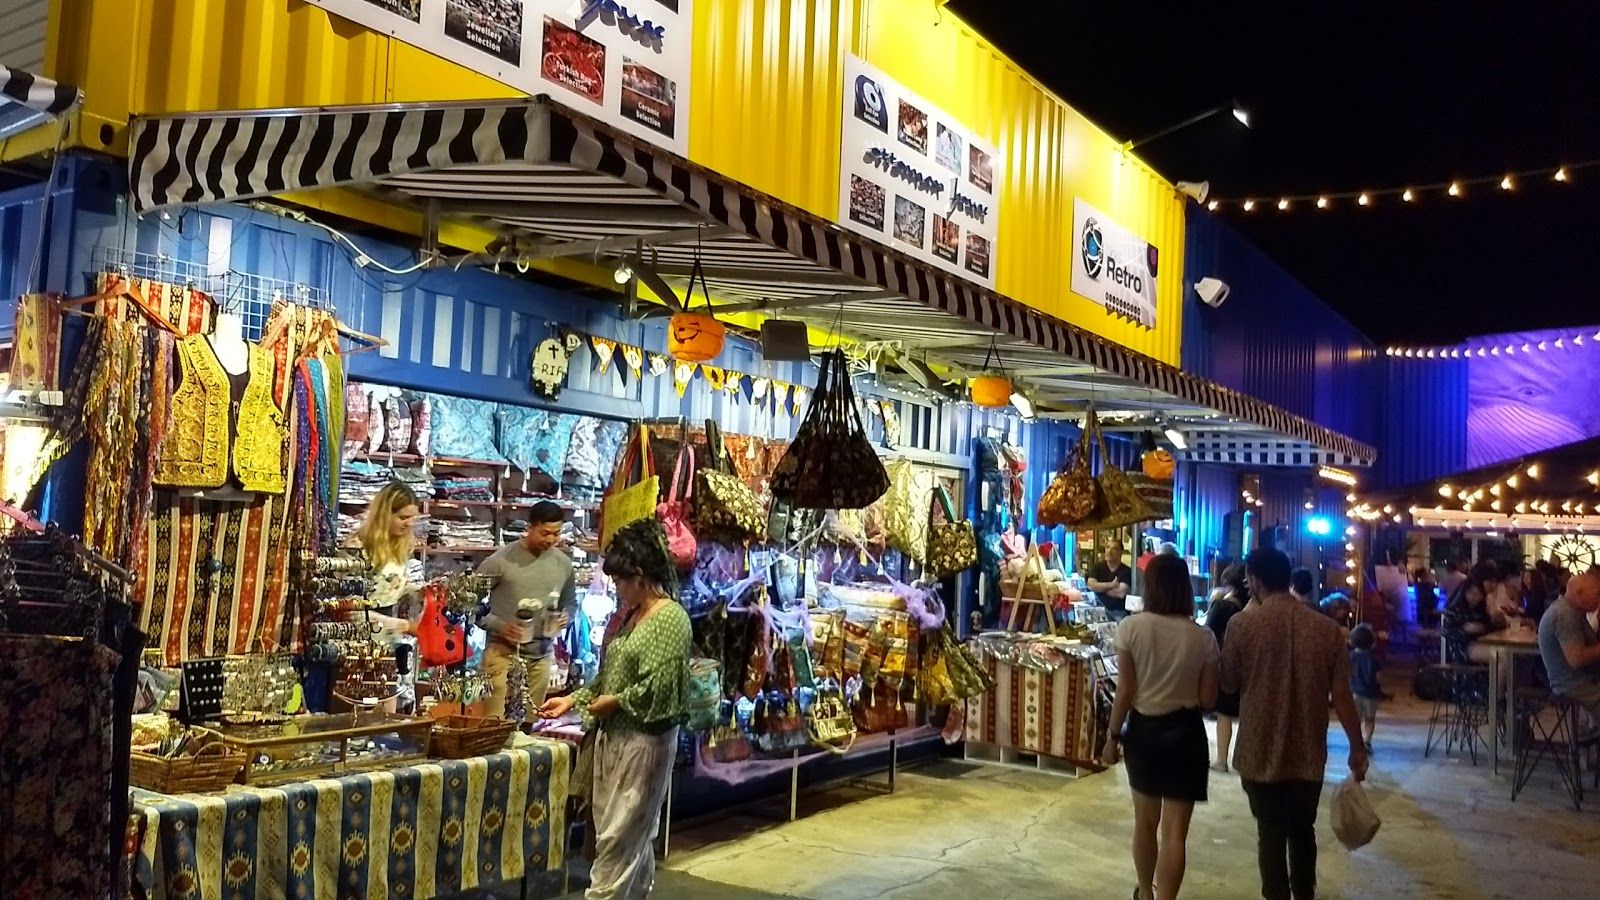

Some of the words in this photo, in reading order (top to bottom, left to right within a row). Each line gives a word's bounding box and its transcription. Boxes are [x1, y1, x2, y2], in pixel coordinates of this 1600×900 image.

[465, 30, 501, 53] Selection
[466, 20, 503, 43] Jewellery
[555, 60, 579, 78] Turkish
[559, 73, 588, 93] Selection
[635, 110, 661, 128] Selection
[638, 102, 660, 118] Ceramic
[1106, 256, 1142, 294] Retro
